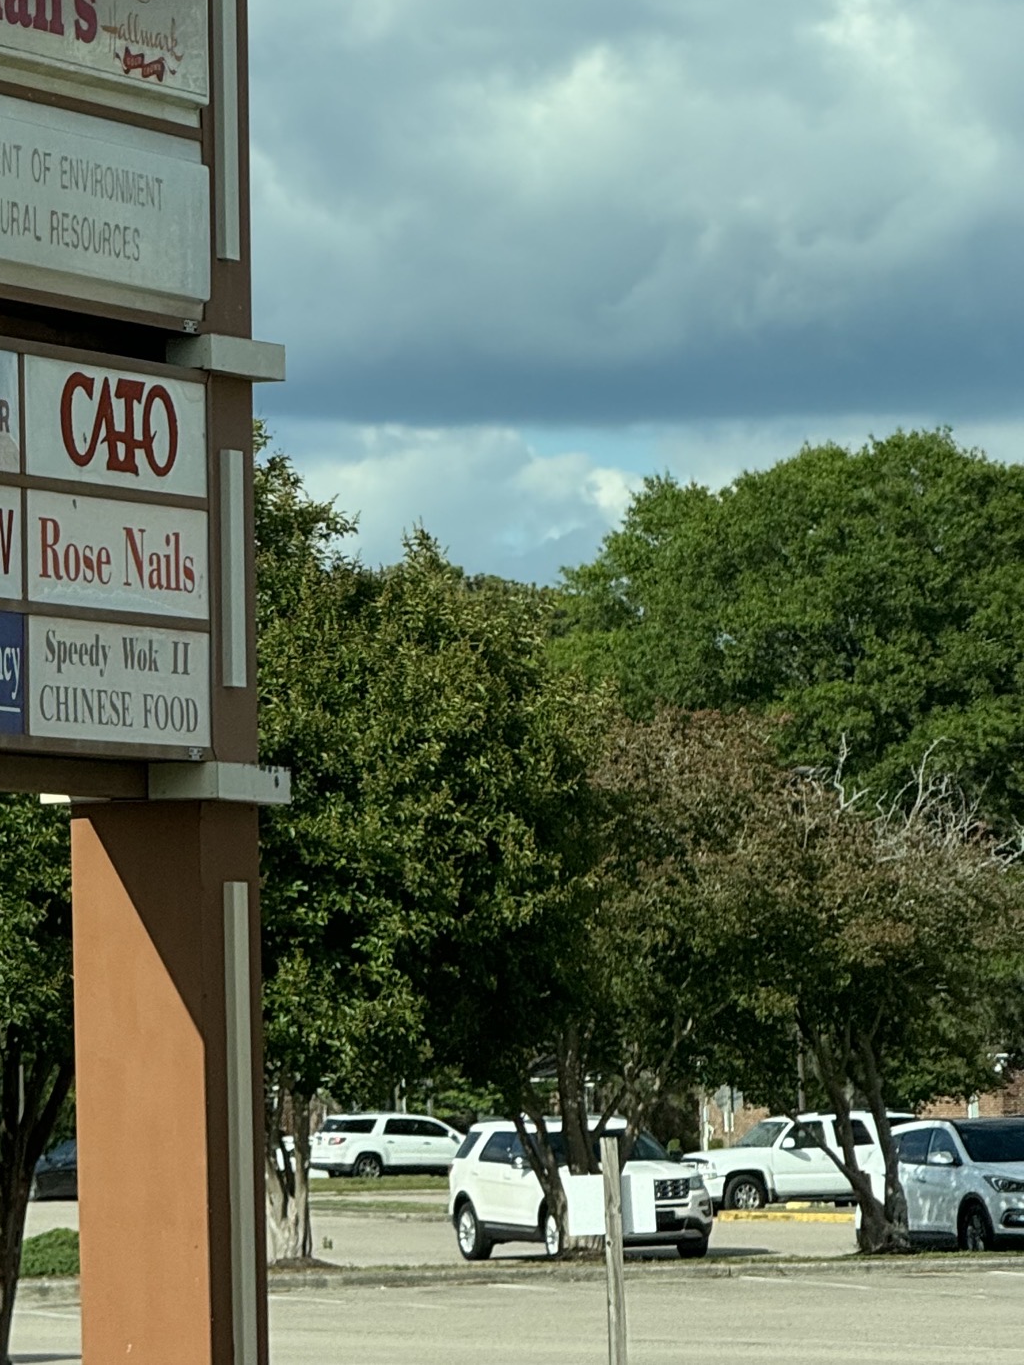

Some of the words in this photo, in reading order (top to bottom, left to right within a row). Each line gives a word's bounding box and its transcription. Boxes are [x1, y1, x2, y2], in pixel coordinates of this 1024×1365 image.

[31, 148, 52, 185] OF
[60, 155, 164, 212] ENVIRONMENT
[50, 209, 141, 262] RESOURCES
[60, 371, 178, 477] CATO
[39, 516, 112, 585] Rose
[123, 526, 196, 594] Nails
[45, 629, 111, 678] Speedy
[122, 636, 160, 674] Wok
[171, 641, 191, 676] II
[39, 683, 134, 729] CHINESE
[142, 693, 199, 733] FOOD
